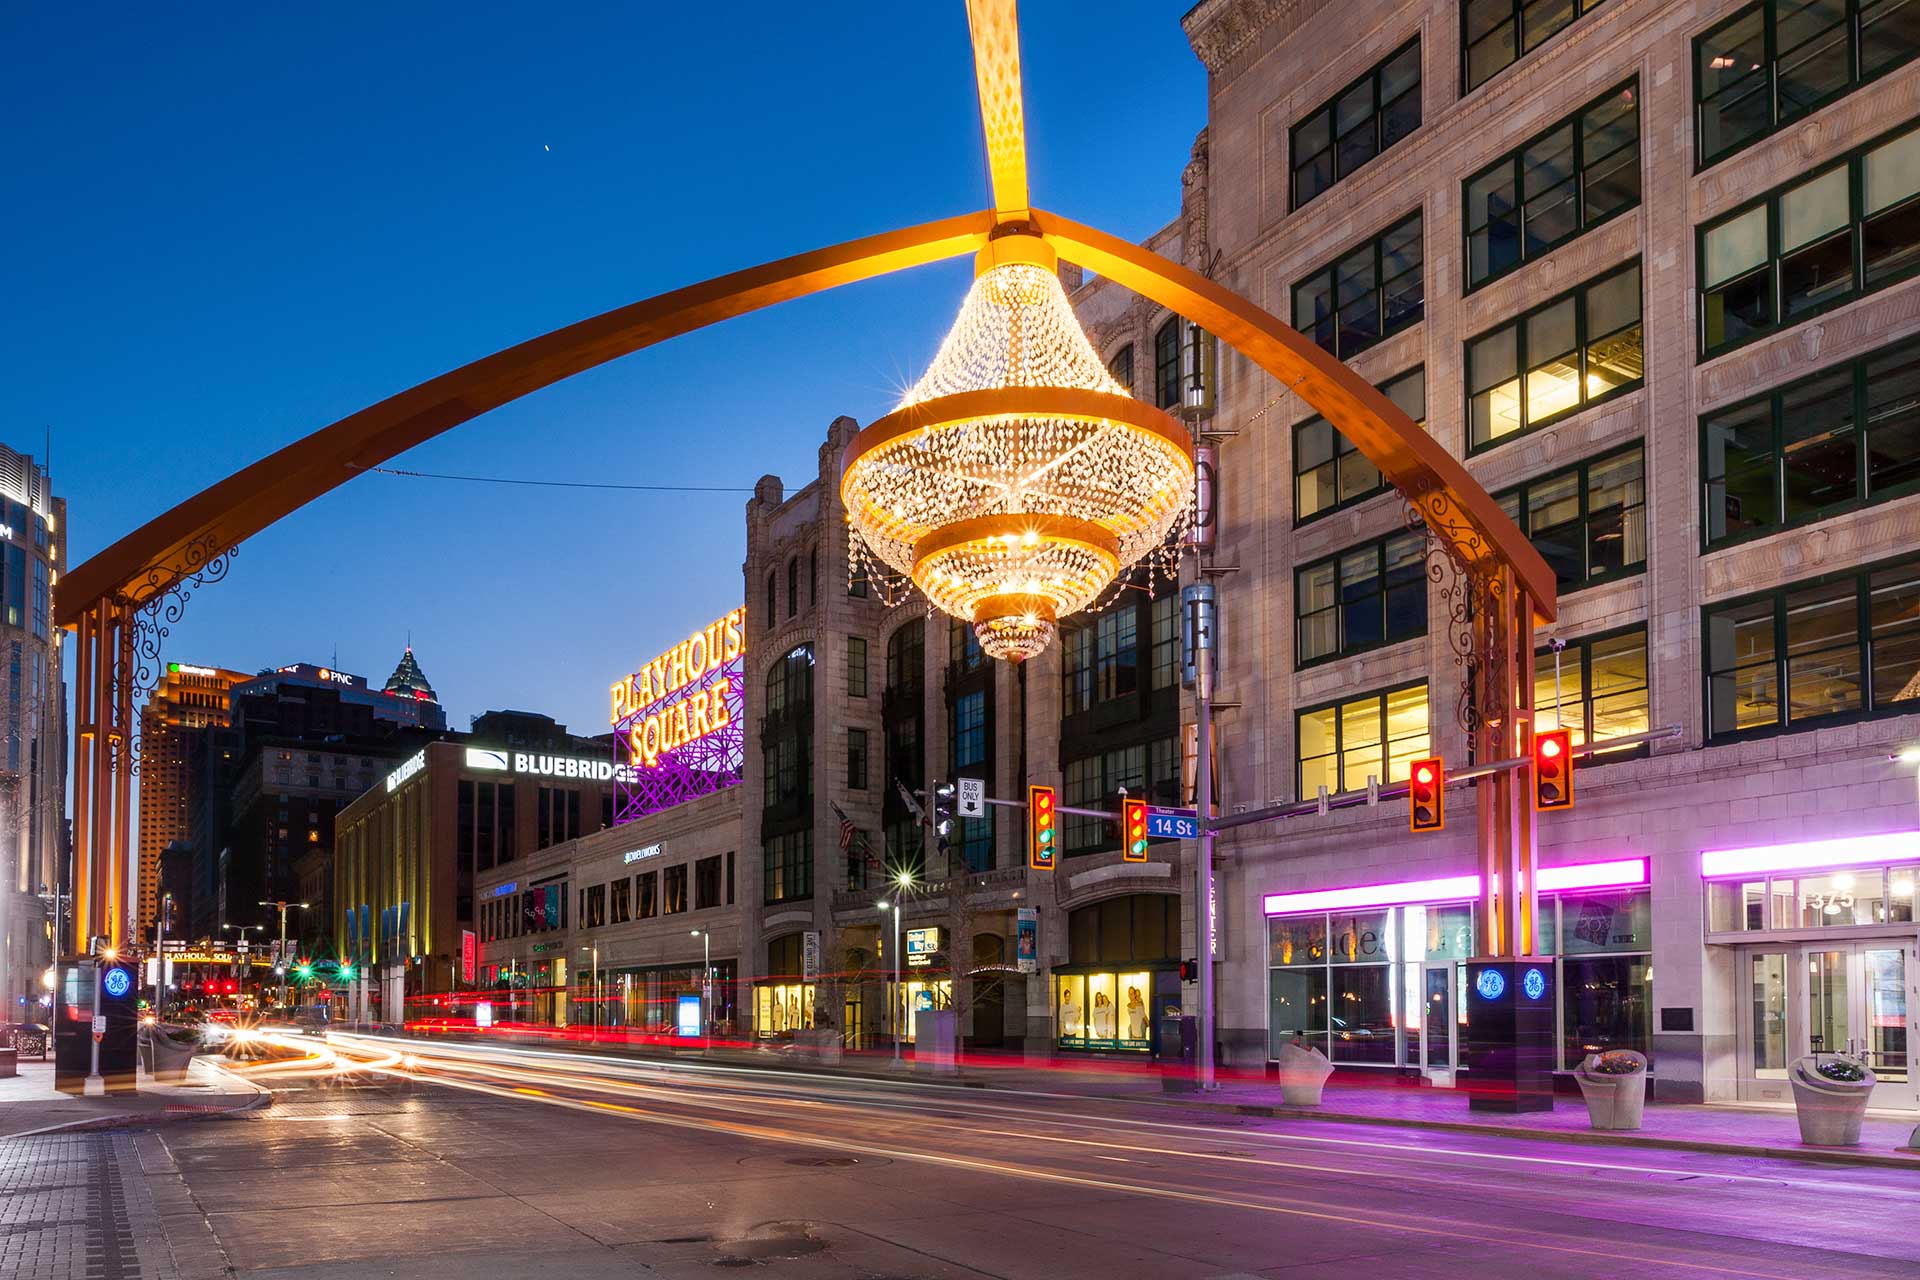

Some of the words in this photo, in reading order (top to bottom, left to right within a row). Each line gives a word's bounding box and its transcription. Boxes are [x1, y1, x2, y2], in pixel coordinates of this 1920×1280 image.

[330, 671, 353, 686] PNC
[630, 678, 731, 769] SQUARE
[963, 782, 978, 792] BUS
[962, 791, 980, 801] ONLY
[1156, 807, 1175, 815] Theater
[1155, 818, 1172, 834] 14
[1176, 819, 1193, 836] St
